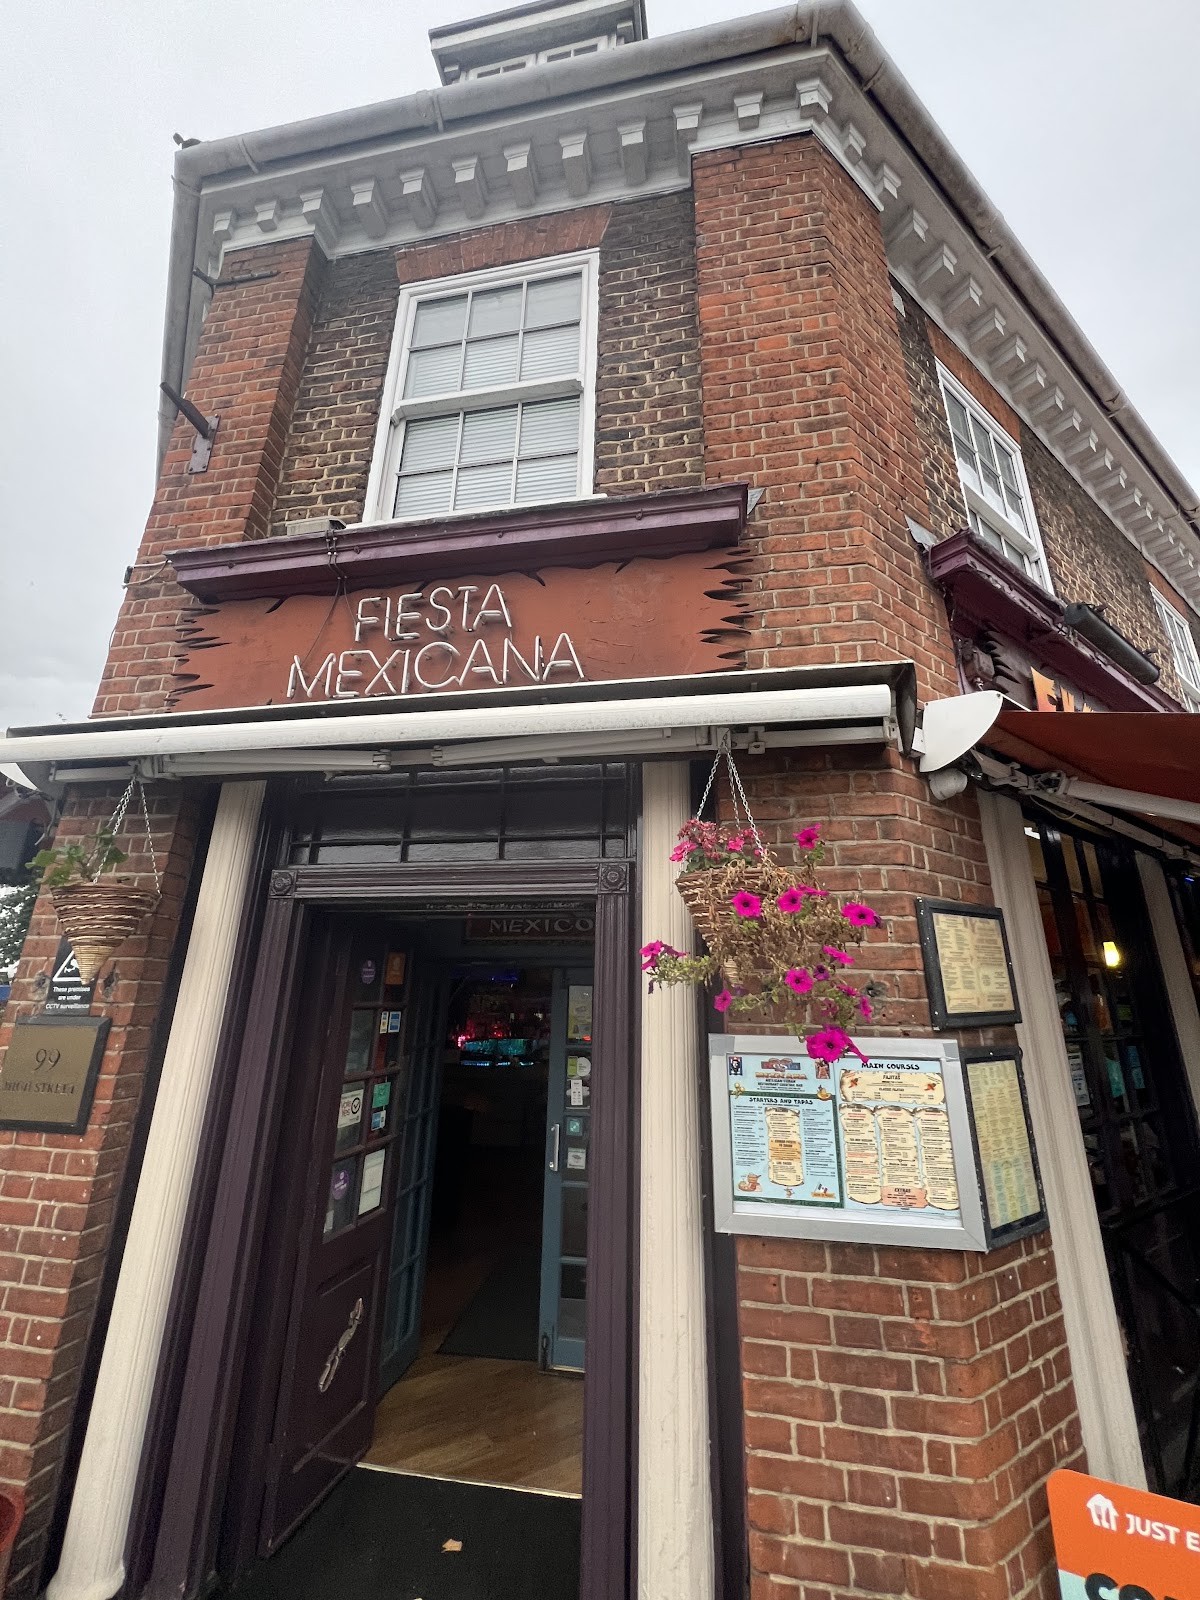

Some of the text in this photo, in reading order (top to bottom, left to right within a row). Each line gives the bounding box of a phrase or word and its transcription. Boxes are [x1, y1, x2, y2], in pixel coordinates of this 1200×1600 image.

[354, 583, 513, 642] FIESTA
[286, 632, 585, 698] MEXICANA
[488, 919, 594, 934] MEXICO
[67, 986, 91, 994] premises
[33, 1048, 61, 1073] 99
[886, 1063, 920, 1071] COURSES
[1125, 1513, 1180, 1545] JUST
